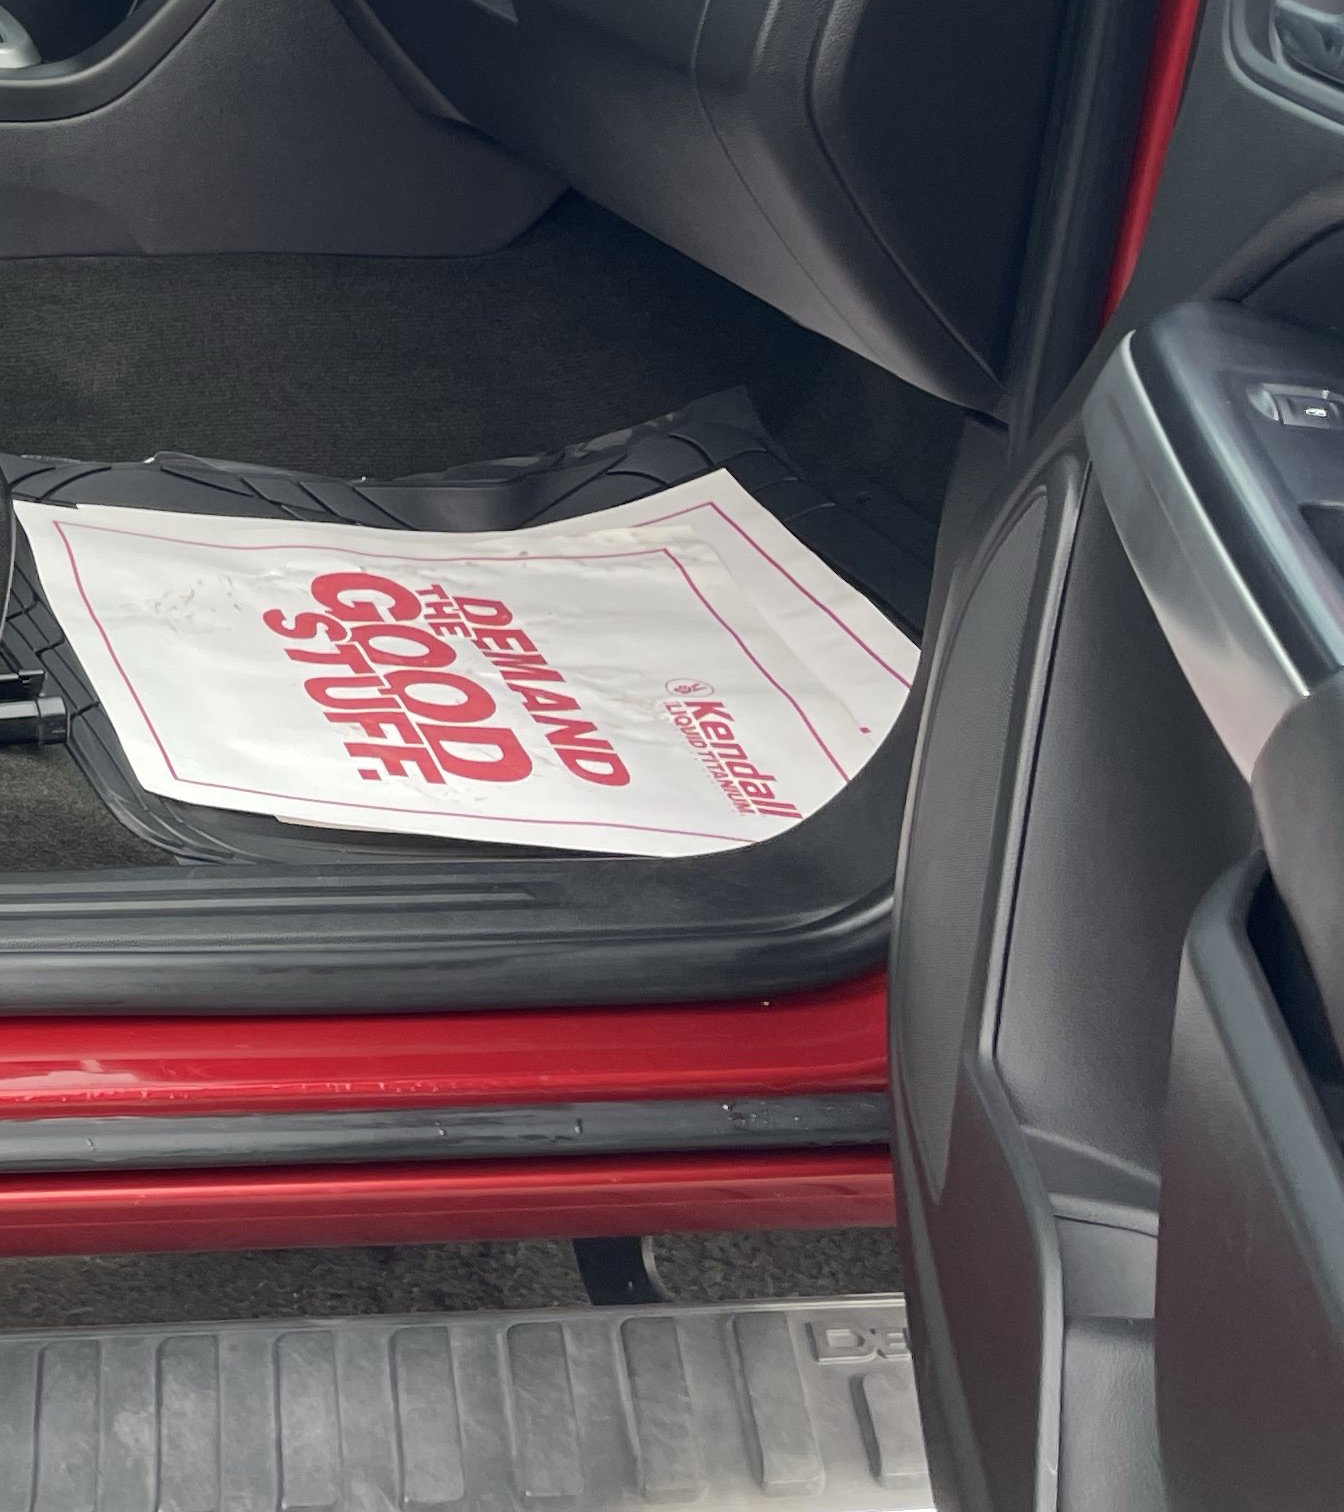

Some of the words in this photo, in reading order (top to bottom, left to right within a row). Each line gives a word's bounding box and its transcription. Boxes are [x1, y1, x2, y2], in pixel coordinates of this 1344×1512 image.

[262, 608, 448, 786] STUFF.
[310, 571, 534, 783] GOOD
[414, 583, 471, 640] THE
[451, 595, 631, 788] DEMAND
[683, 701, 804, 819] Kendall
